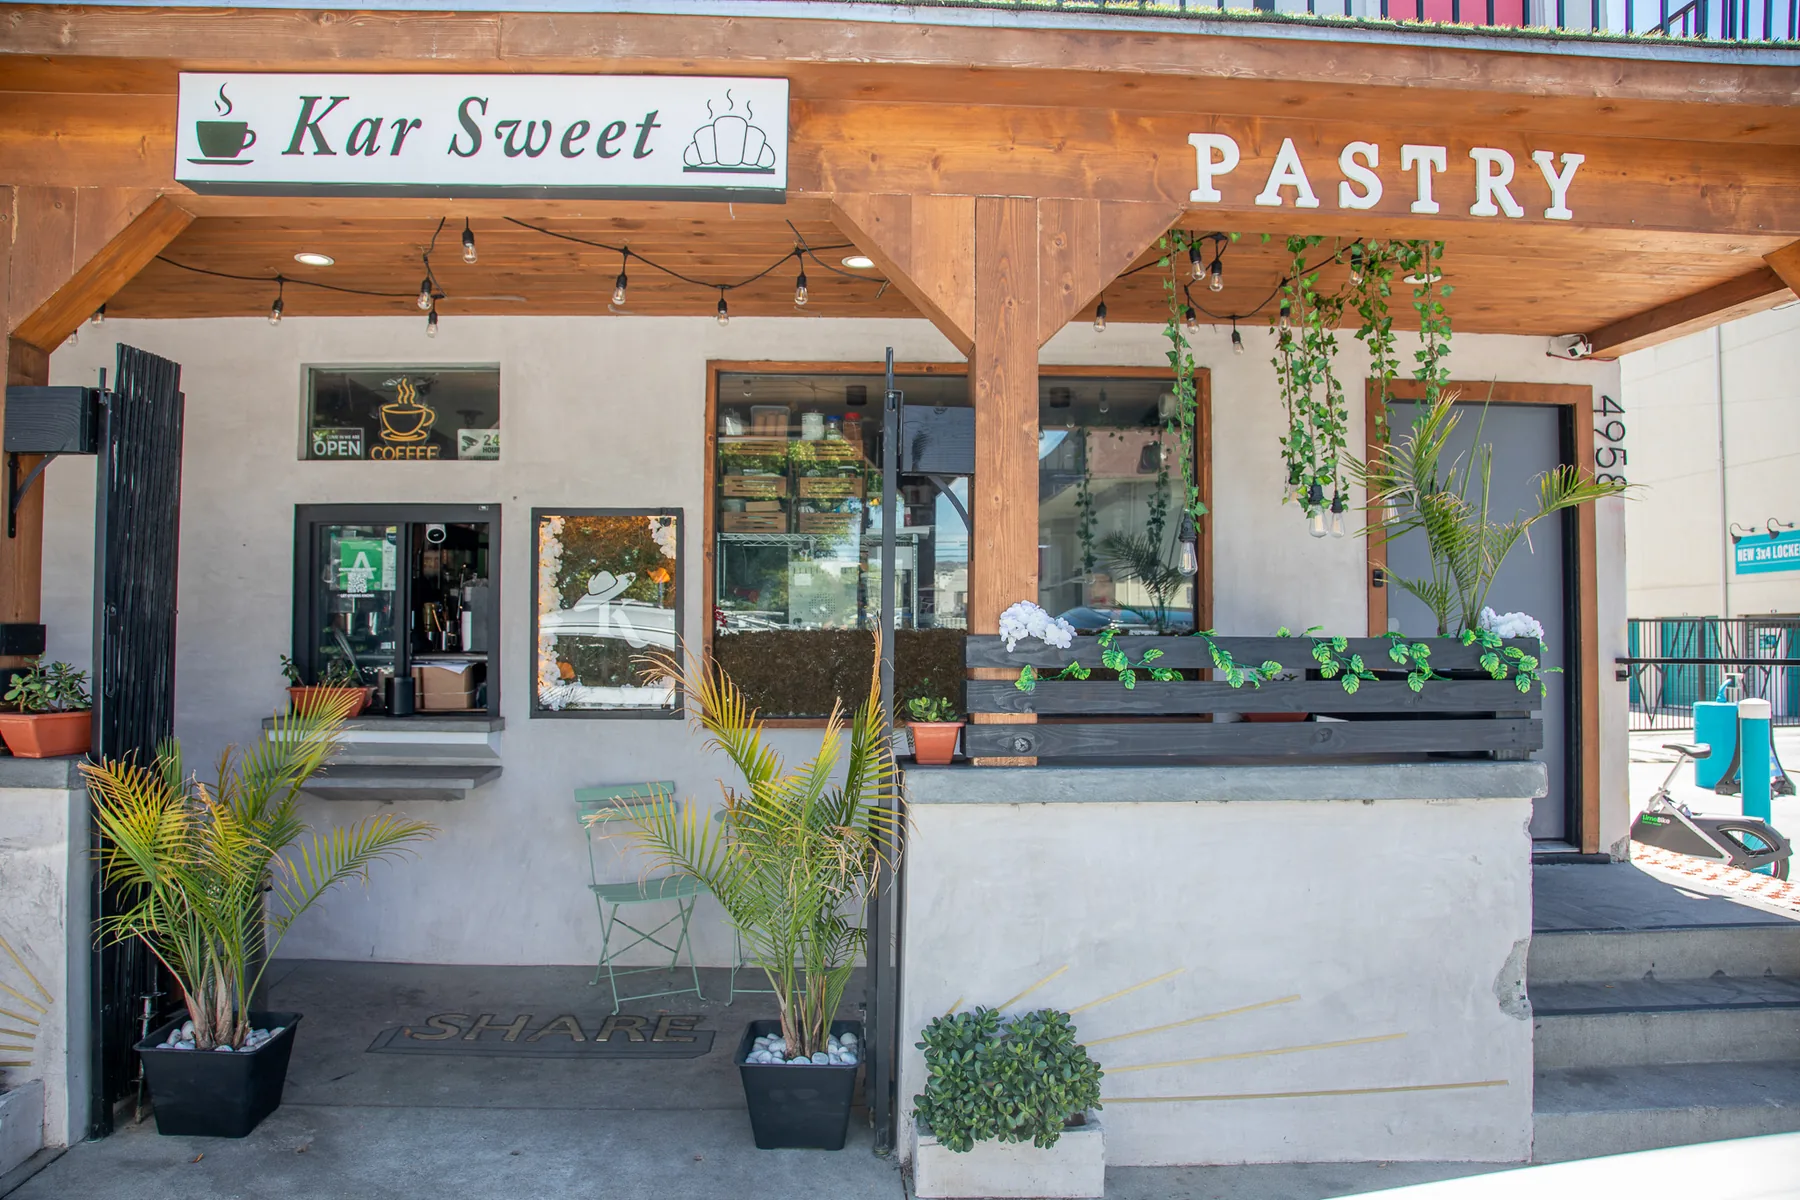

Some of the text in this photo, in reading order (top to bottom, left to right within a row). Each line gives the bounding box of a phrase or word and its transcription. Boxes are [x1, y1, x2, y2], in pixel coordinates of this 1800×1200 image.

[281, 95, 662, 159] Kar Sweet
[1187, 132, 1586, 220] PASTRY
[313, 441, 361, 456] OPEN
[483, 434, 500, 446] 24
[1737, 548, 1755, 562] NEW
[1756, 546, 1771, 560] 3x4
[410, 1012, 707, 1044] SHARE
